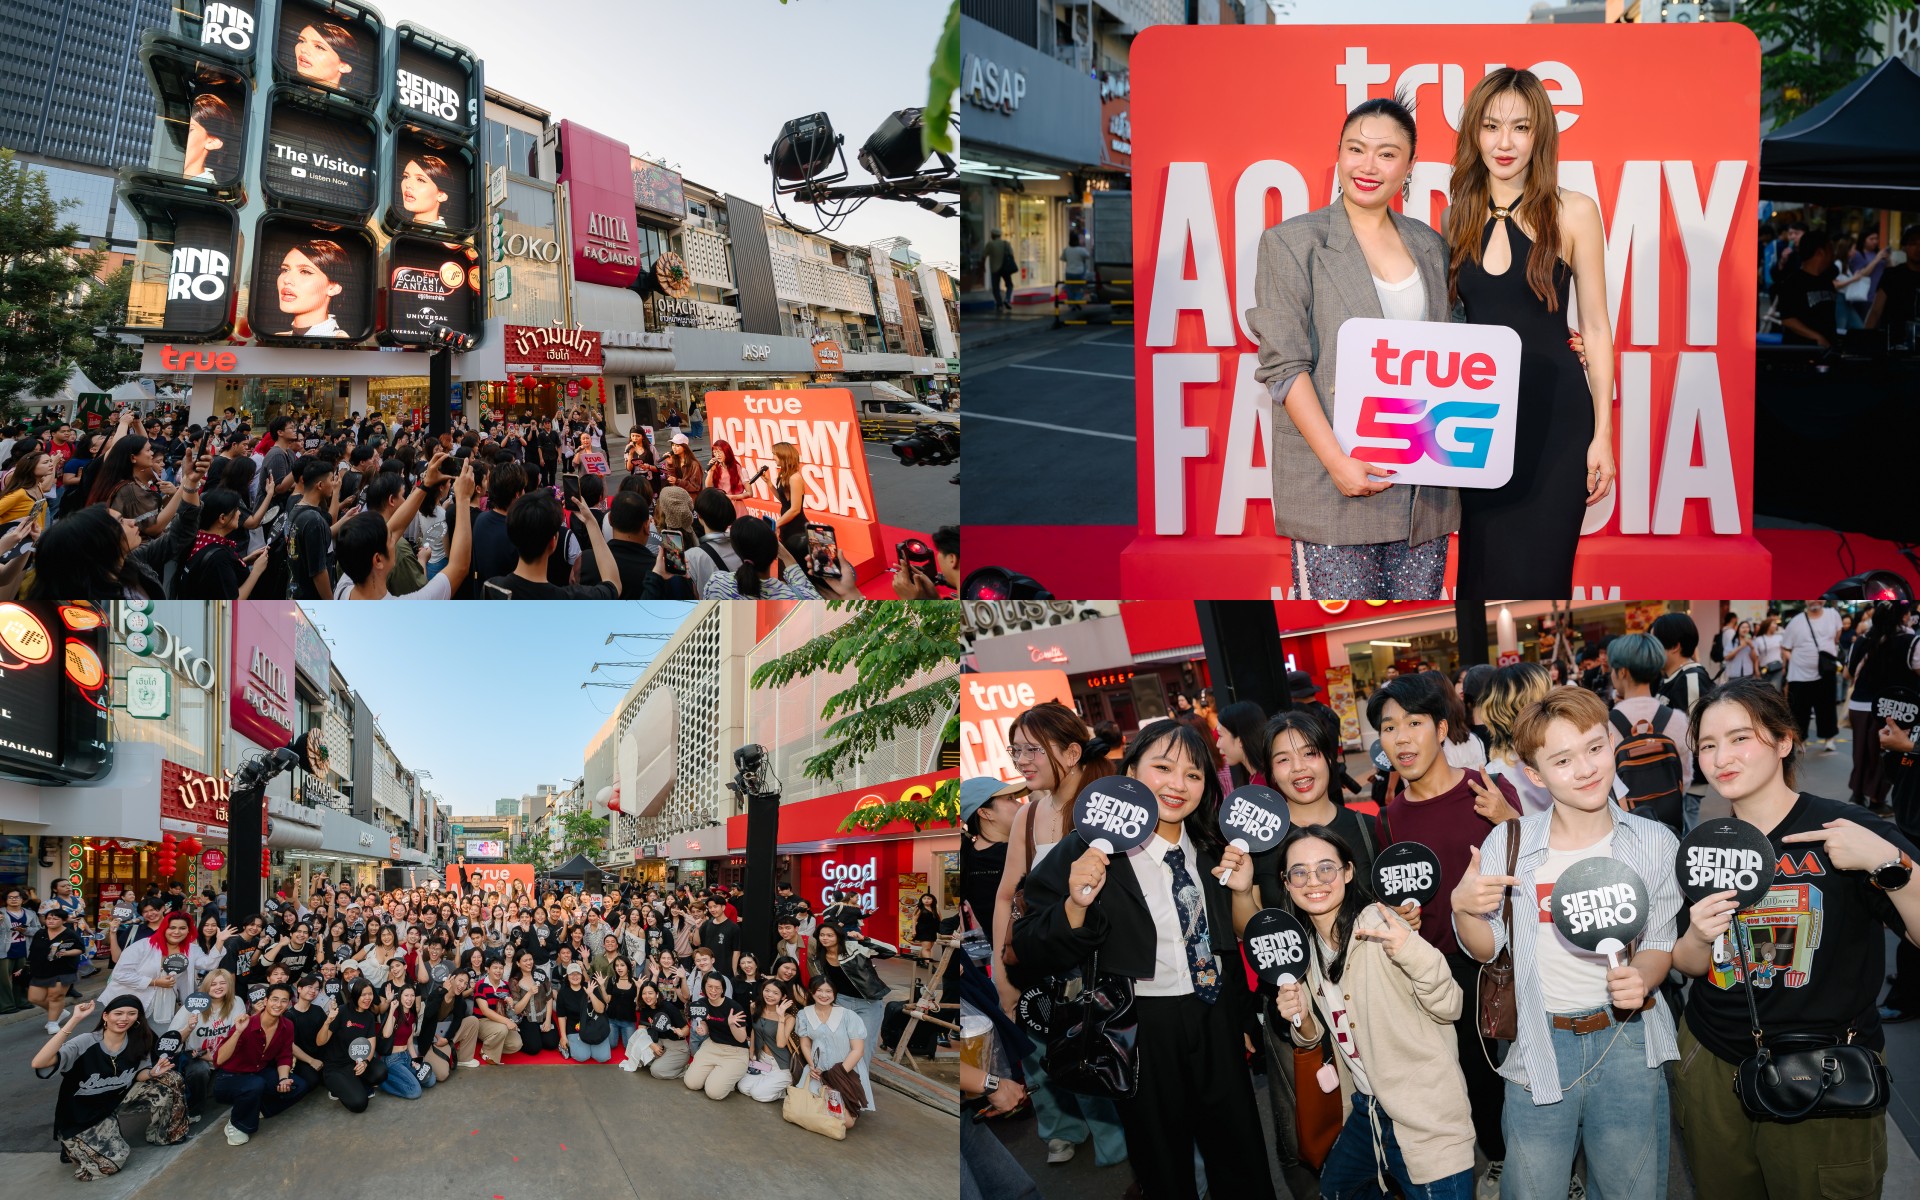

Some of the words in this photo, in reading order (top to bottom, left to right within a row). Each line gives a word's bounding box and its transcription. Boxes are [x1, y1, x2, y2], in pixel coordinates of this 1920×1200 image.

[397, 69, 460, 108] SIENNA
[969, 56, 1026, 110] ASAP
[400, 87, 458, 121] SPIRO
[275, 143, 308, 164] The
[312, 153, 366, 177] Visitor
[309, 172, 331, 183] Listen
[332, 178, 349, 187] Now
[583, 245, 638, 267] FACIALIST
[604, 240, 617, 249] THE
[395, 280, 445, 294] FANTASIA
[398, 273, 440, 286] ACADEMY
[406, 313, 449, 322] UNIVERSAL
[515, 320, 597, 357] ข้าวมันไก่
[160, 345, 238, 371] true
[743, 344, 771, 361] ASAP
[1370, 338, 1497, 390] true
[744, 395, 802, 414] true
[1350, 395, 1501, 469] 5G
[586, 463, 607, 473] 5G
[969, 680, 1036, 712] true
[1877, 697, 1919, 715] SIENNA
[1876, 708, 1916, 723] SPIRO
[1086, 791, 1149, 825] SIENNA
[1230, 796, 1282, 832] SIENNA
[1081, 807, 1141, 839] SPIRO
[1225, 810, 1274, 842] SPIRO
[821, 857, 877, 881] Good
[1686, 845, 1763, 871] SIENNA
[834, 872, 870, 890] food
[1379, 861, 1434, 884] SIENNA
[1383, 874, 1433, 896] SPIRO
[1688, 866, 1759, 891] SPIRO
[821, 886, 877, 911] Gd
[1560, 882, 1637, 916] SIENNA
[1568, 902, 1637, 935] SPIRO
[1761, 915, 1797, 924] SHOWING
[1249, 929, 1302, 957] SIENNA
[1256, 945, 1304, 970] SPIRO
[1023, 987, 1043, 1001] HILL
[1019, 999, 1029, 1019] THIS
[1028, 1020, 1042, 1032] ON
